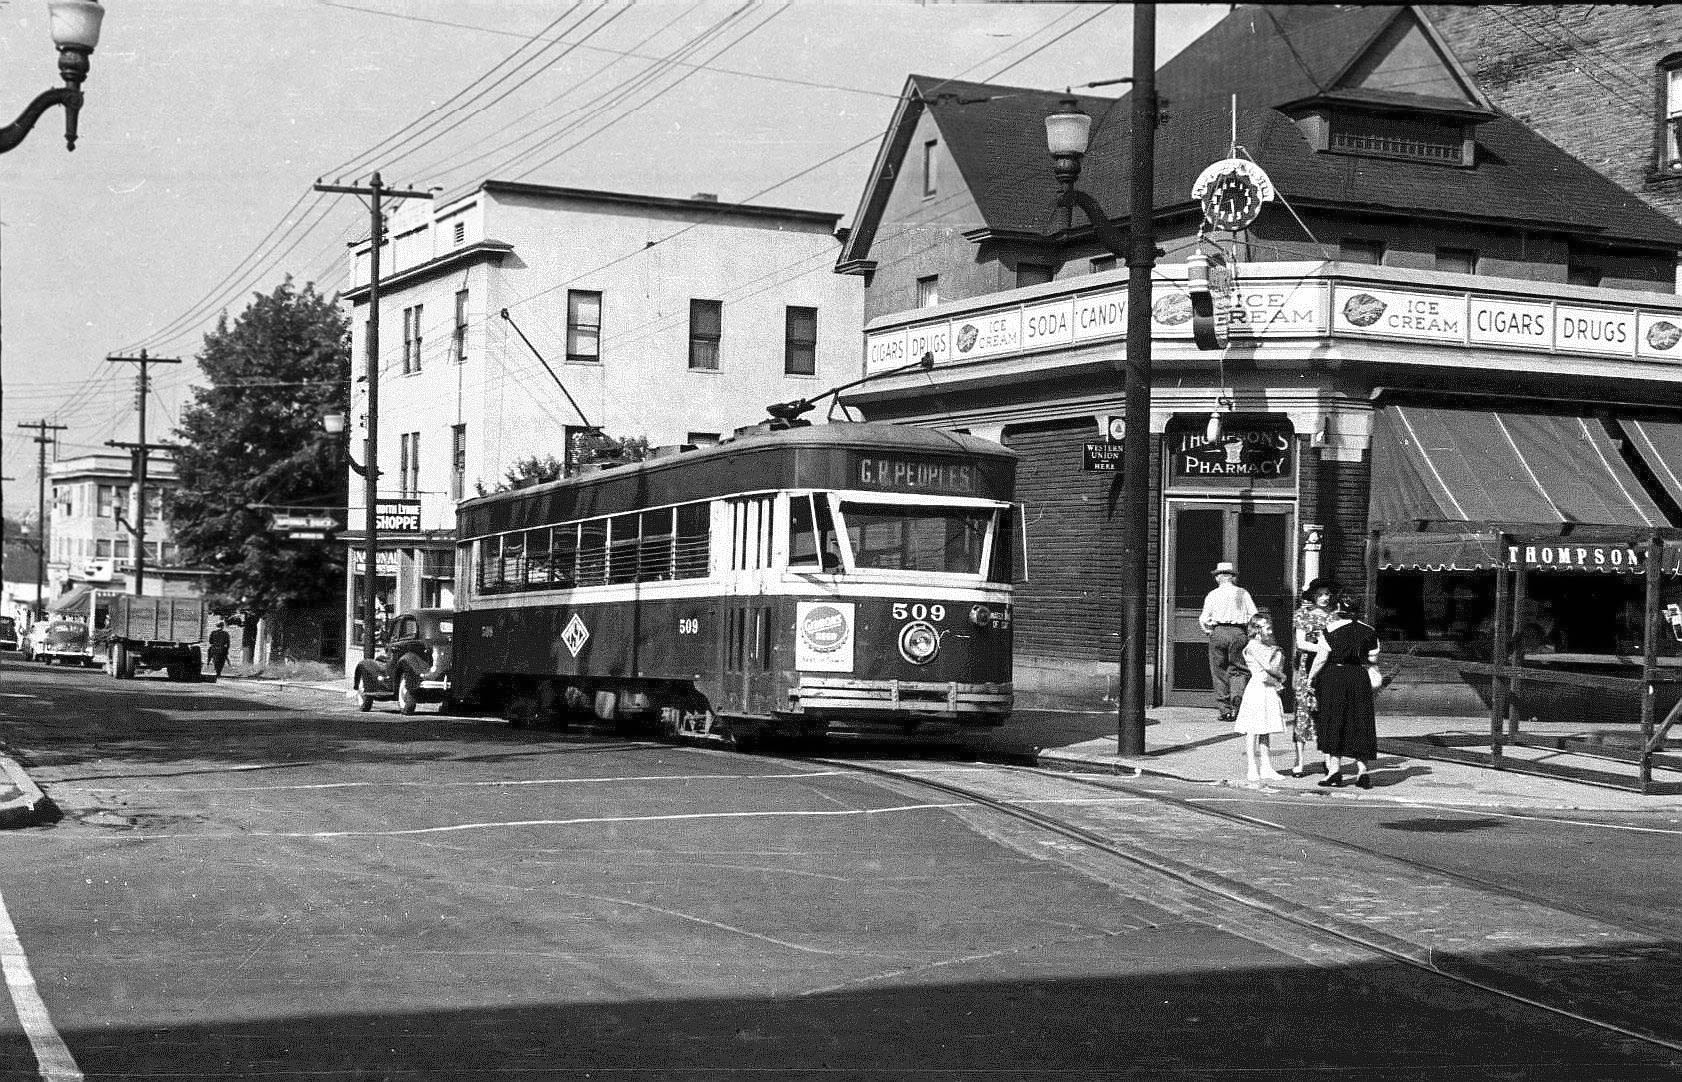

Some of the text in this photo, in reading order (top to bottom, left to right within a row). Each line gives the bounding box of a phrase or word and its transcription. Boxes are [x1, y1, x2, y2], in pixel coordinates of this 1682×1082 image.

[1234, 294, 1285, 308] ICE
[1408, 300, 1440, 315] ICE
[1080, 301, 1127, 329] CANDY
[1228, 310, 1314, 324] REAM
[1388, 314, 1458, 333] CREAM
[1477, 309, 1545, 336] CIGARS
[989, 319, 1007, 333] ICE
[1028, 312, 1067, 338] SODA
[1563, 317, 1627, 343] DRUGS
[912, 333, 946, 356] DRUGS
[979, 332, 1017, 349] CREAM
[871, 340, 904, 363] CIGARS
[1185, 456, 1284, 474] PHARMACY
[376, 515, 419, 530] SHOPPE
[892, 602, 946, 622] 509
[680, 618, 698, 634] 509
